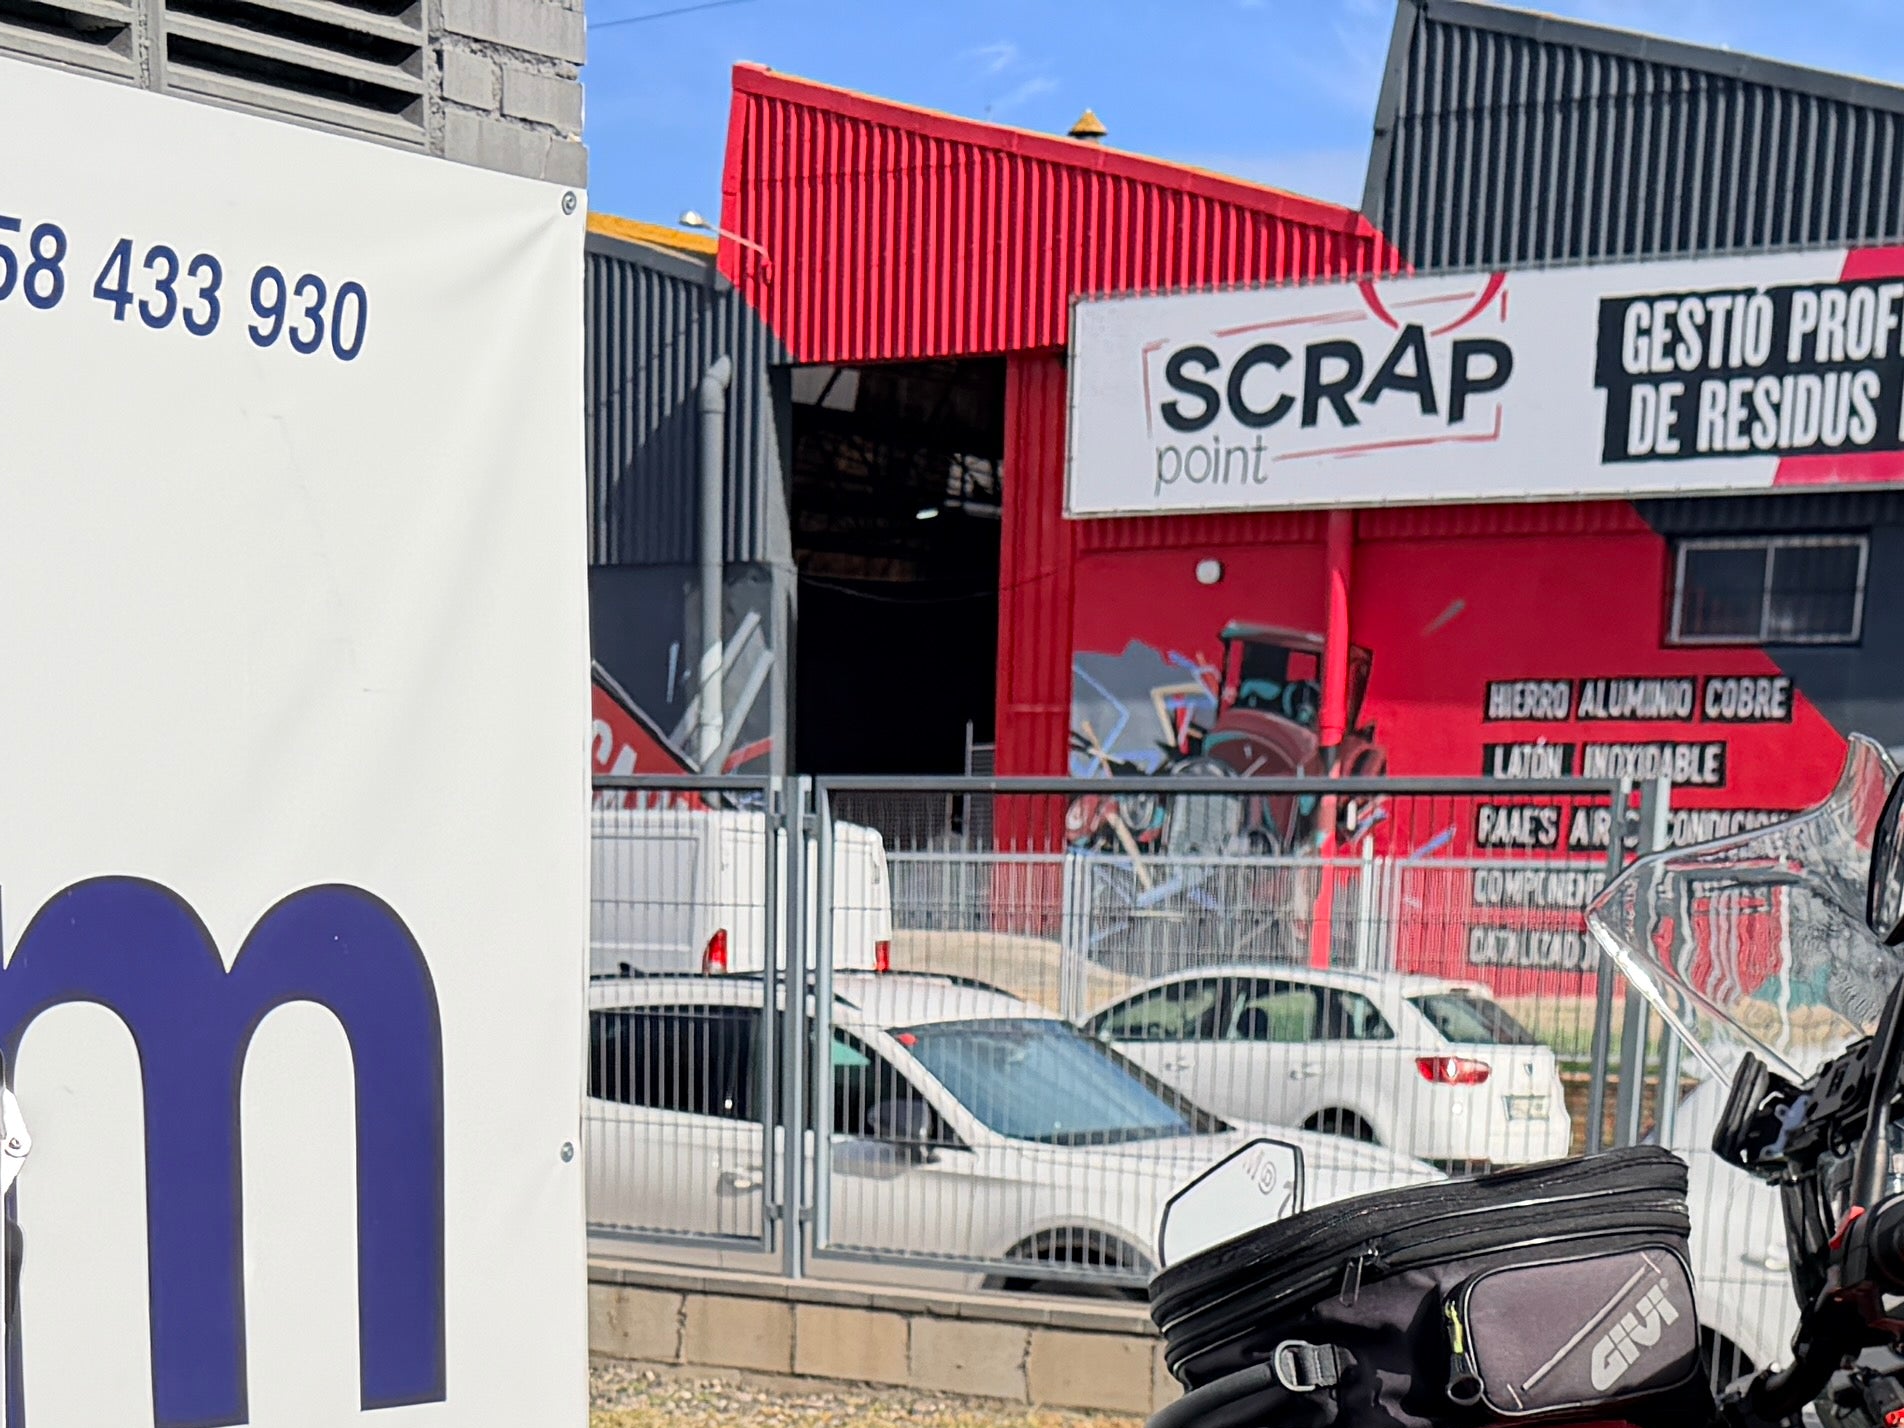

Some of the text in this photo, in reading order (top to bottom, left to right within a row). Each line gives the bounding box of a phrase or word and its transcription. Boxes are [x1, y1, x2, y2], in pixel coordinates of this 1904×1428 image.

[94, 238, 223, 337] 433
[248, 266, 369, 362] 930
[1621, 268, 1773, 374] GESTIÓ
[1159, 323, 1515, 434] SCRAP
[1627, 382, 1685, 455] DE
[1696, 369, 1880, 452] RESIDUS
[1155, 434, 1269, 496] point
[1489, 676, 1791, 720] HIERRO ALUMINIO COBRE
[1493, 737, 1721, 784] LATÓN INOXIDABLE
[1589, 1284, 1679, 1392] GIVI
